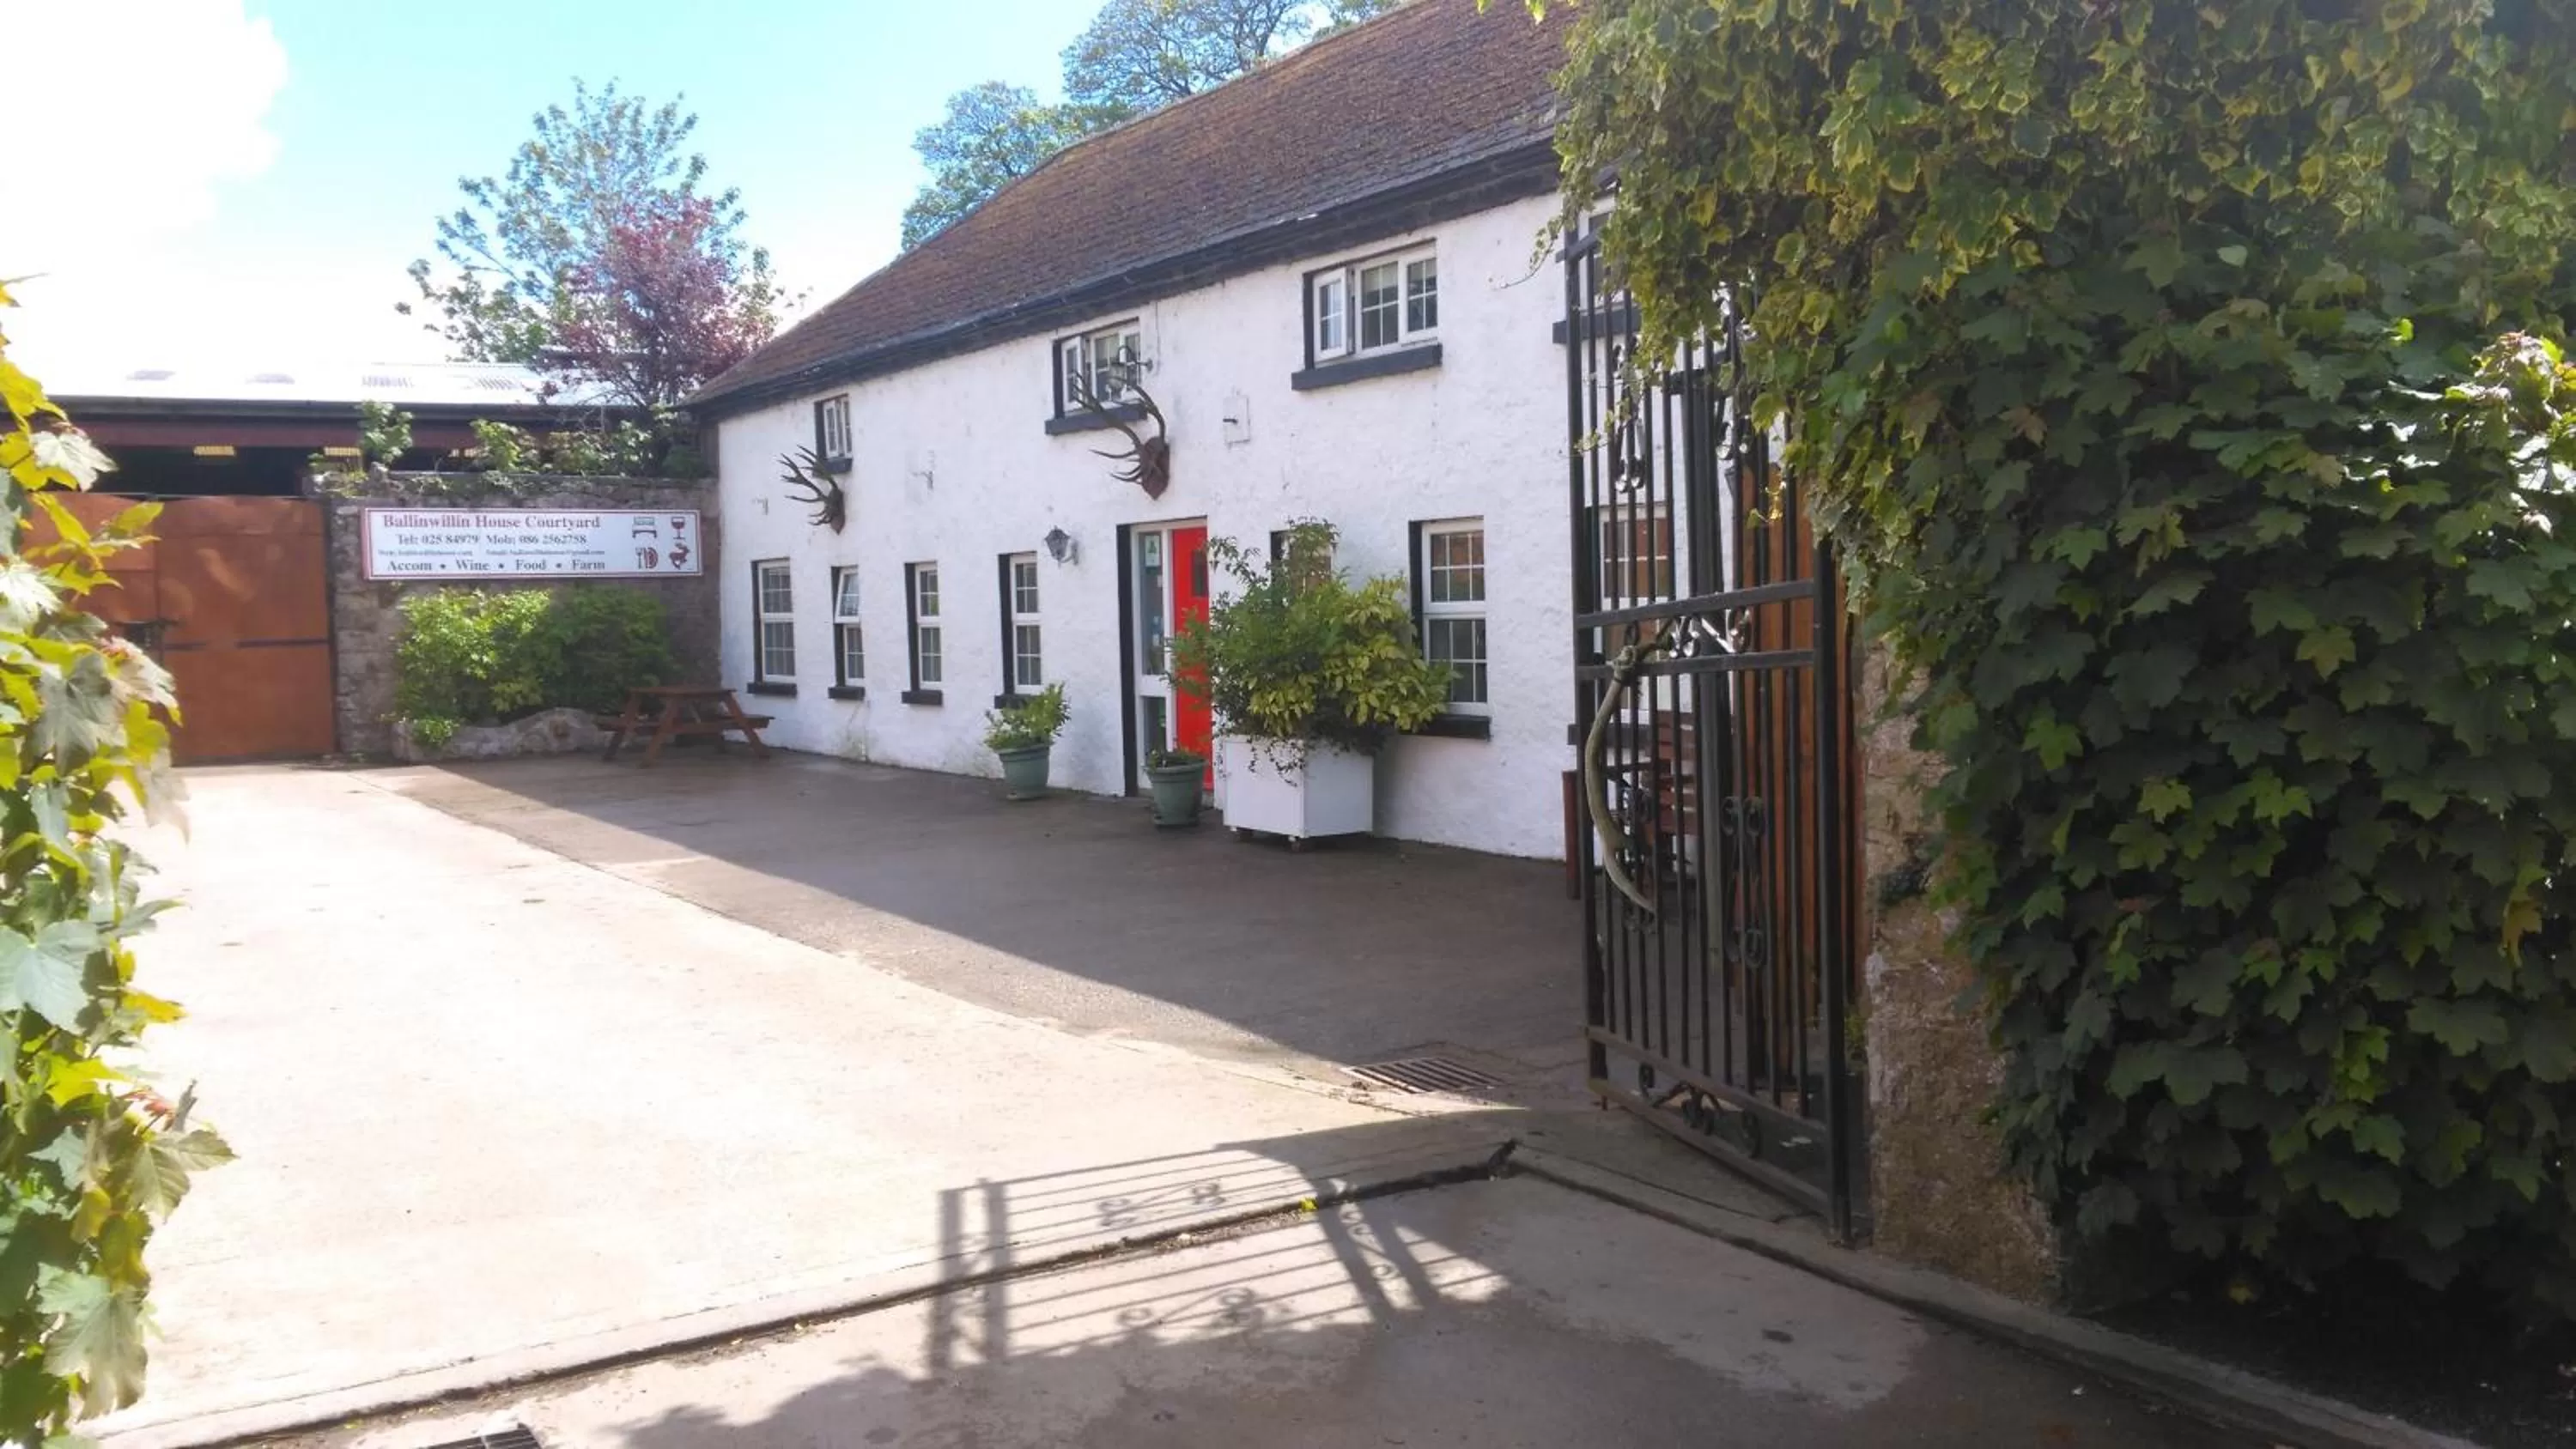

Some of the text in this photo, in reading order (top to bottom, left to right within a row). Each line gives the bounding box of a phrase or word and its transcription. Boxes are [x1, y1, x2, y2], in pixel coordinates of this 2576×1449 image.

[384, 515, 600, 530] Ballinwillin House Courtyard
[397, 534, 418, 545] Tel:
[422, 534, 442, 545] 025
[486, 534, 515, 545] Mob:
[388, 560, 605, 571] Accom Wine Food Farm
